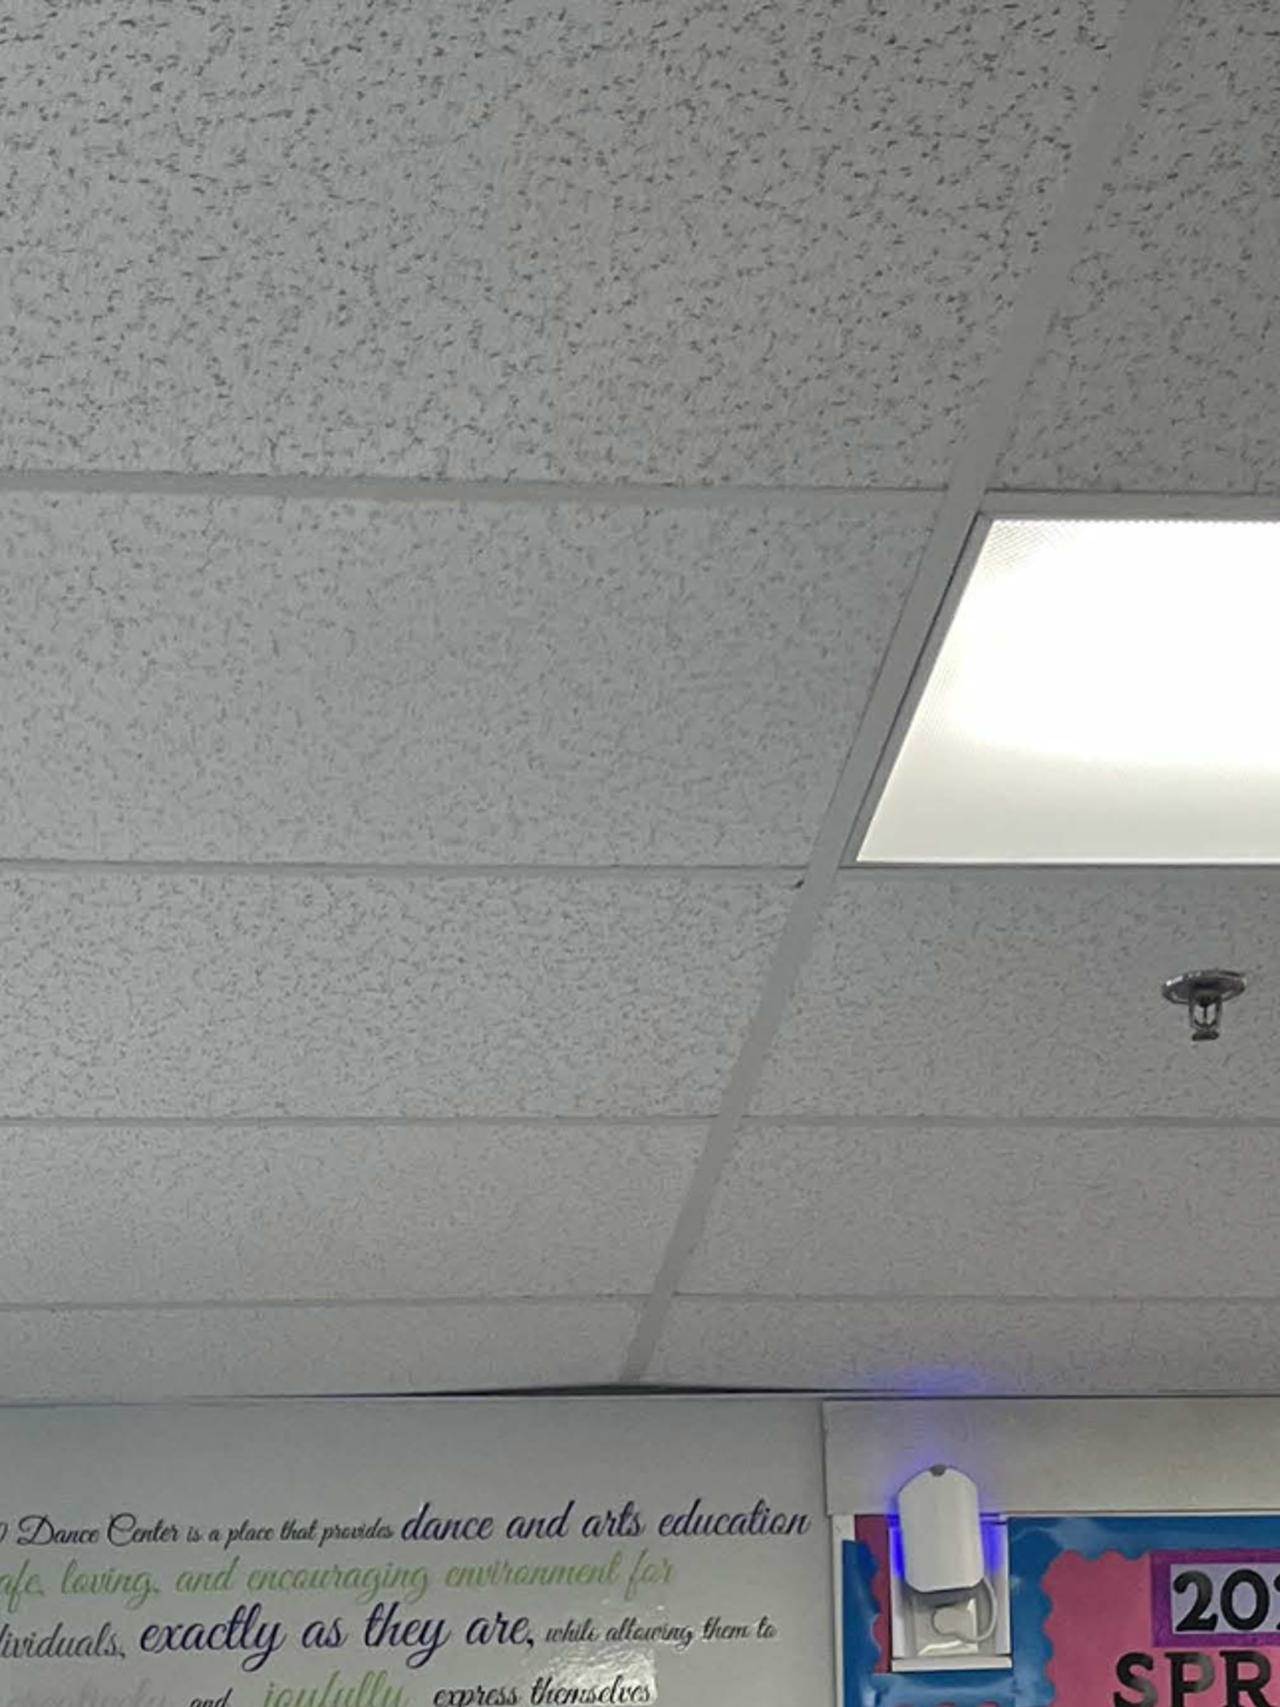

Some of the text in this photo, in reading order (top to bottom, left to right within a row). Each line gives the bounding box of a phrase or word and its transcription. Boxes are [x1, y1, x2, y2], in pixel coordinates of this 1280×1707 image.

[16, 1514, 100, 1546] Dance
[106, 1512, 179, 1546] Center
[186, 1525, 202, 1543] is
[208, 1530, 221, 1543] a
[223, 1519, 274, 1550] place
[279, 1518, 318, 1543] that
[318, 1516, 394, 1548] provides
[401, 1501, 495, 1541] dance
[505, 1499, 576, 1540] and
[581, 1500, 647, 1540] arts
[658, 1498, 811, 1538] education
[175, 1555, 241, 1593] and
[246, 1560, 429, 1606] encouraging
[445, 1554, 622, 1589] environment
[622, 1547, 674, 1601] for
[140, 1602, 289, 1672] exactly
[301, 1616, 350, 1649] as
[363, 1601, 453, 1669] they
[465, 1609, 535, 1650] are,
[544, 1619, 600, 1643] while
[604, 1616, 694, 1652] allowing
[701, 1615, 752, 1641] them
[756, 1615, 778, 1640] to
[530, 1675, 652, 1707] themselves
